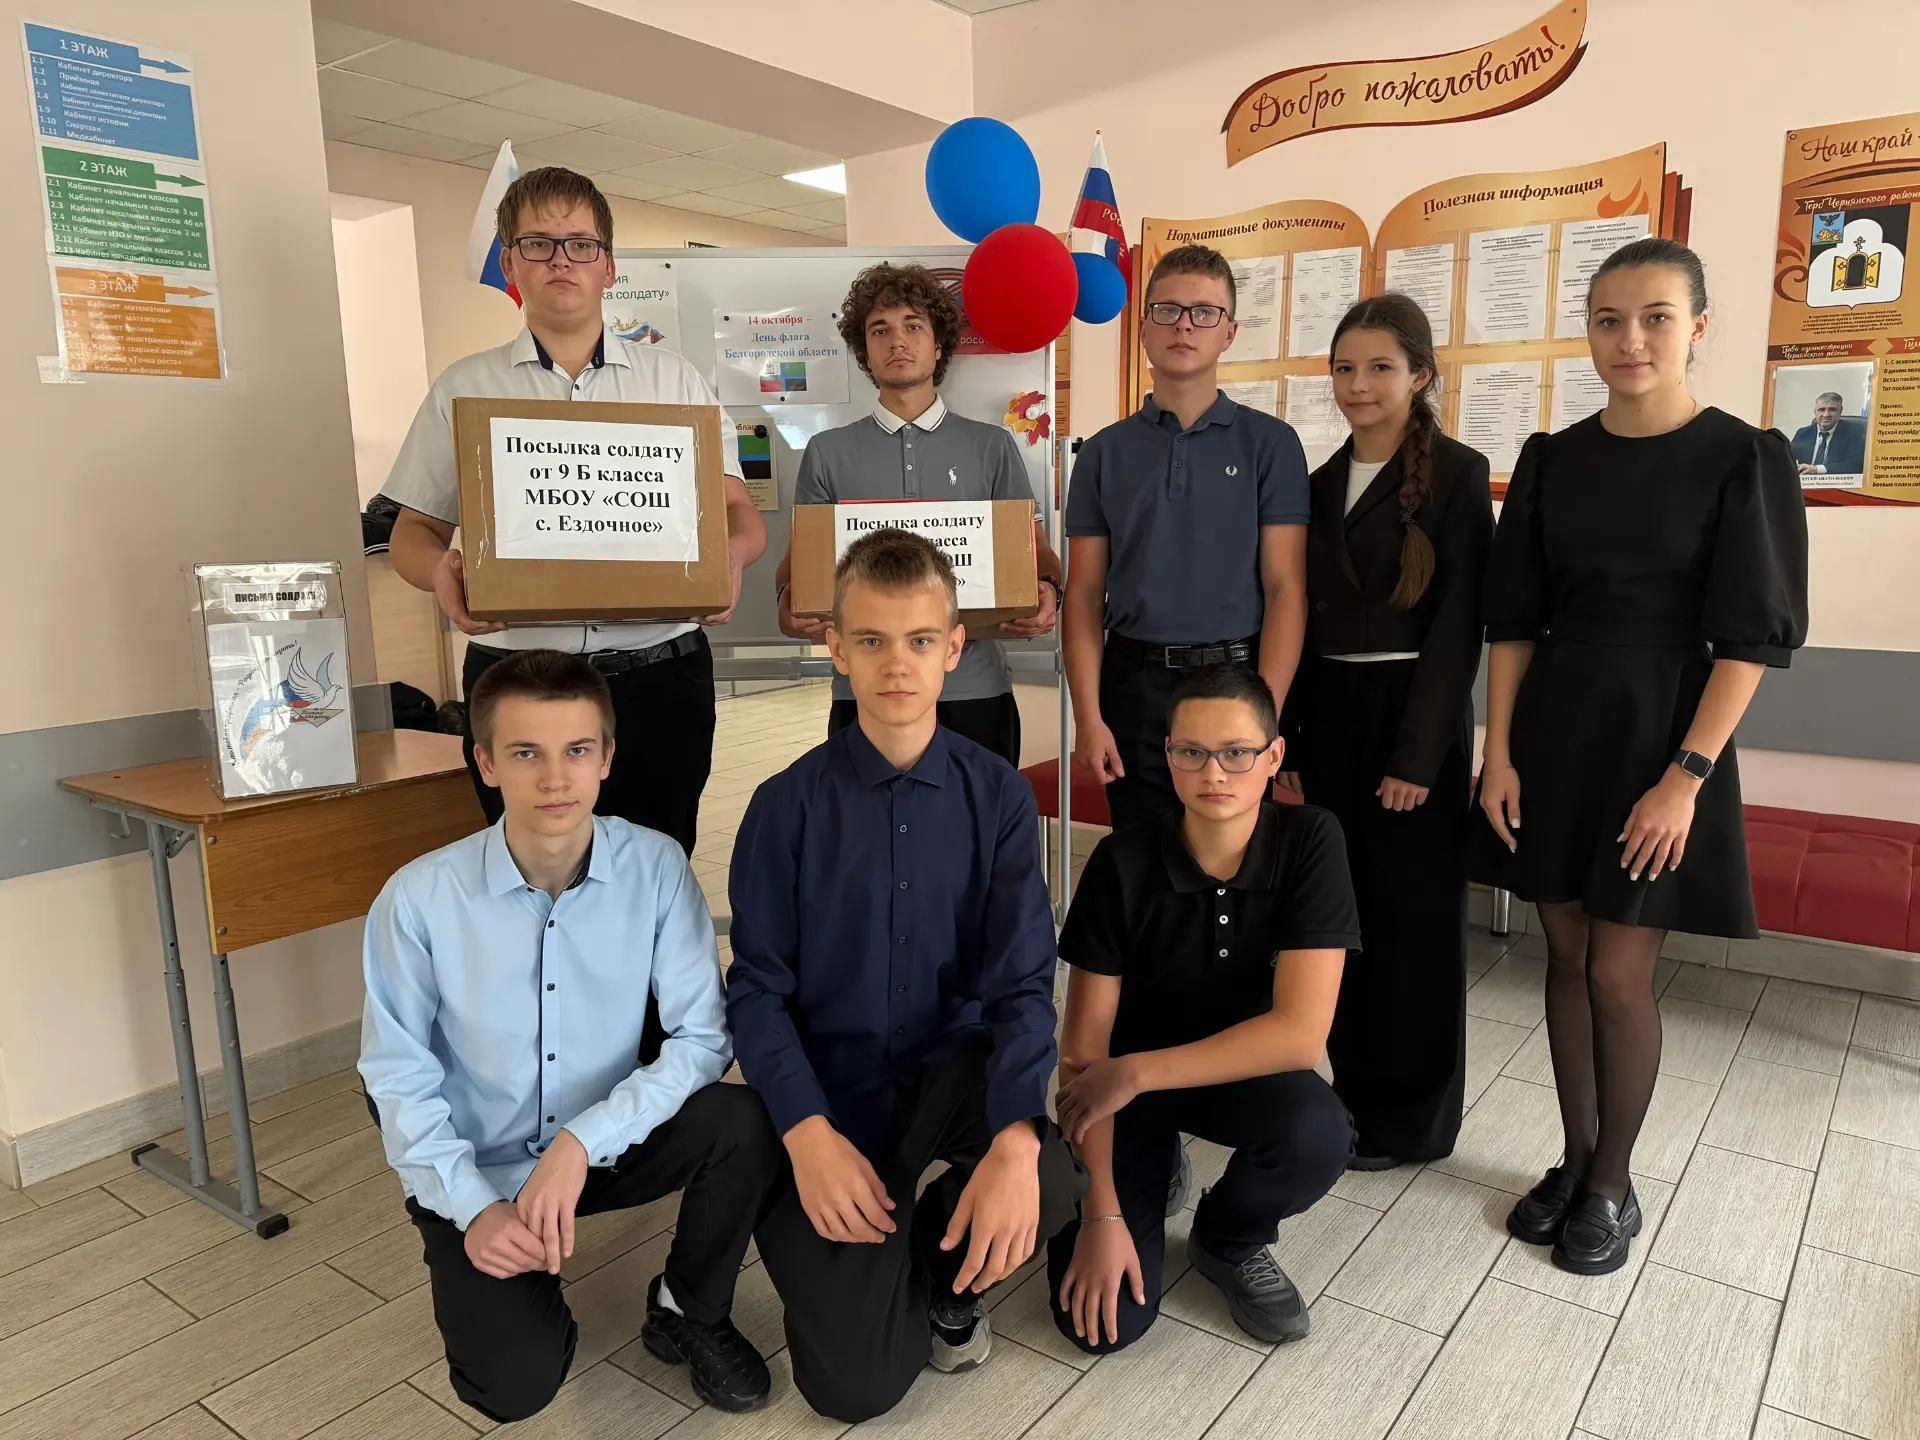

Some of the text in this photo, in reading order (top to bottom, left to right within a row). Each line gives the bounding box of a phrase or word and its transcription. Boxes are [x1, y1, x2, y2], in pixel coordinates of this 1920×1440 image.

[60, 40, 109, 59] 1 ЭТАЖ
[32, 56, 133, 83] 1.1 Кабинет директора
[34, 67, 100, 85] 1.2 Приёмная
[1249, 25, 1566, 132] Добро пожаловать!
[61, 83, 88, 92] Кабинет
[90, 88, 130, 101] заместителя
[132, 96, 165, 108] директора
[62, 96, 89, 106] Кабинет
[92, 101, 132, 114] заместителя
[133, 109, 167, 120] директора
[40, 116, 101, 133] 1.10 Спортзал
[64, 110, 96, 121] Кабинет
[98, 116, 129, 127] истории
[41, 127, 115, 145] 1.11 Медкабинет
[1801, 128, 1912, 162] Наш край
[80, 161, 127, 177] 2 ЭТАЖ
[68, 181, 101, 193] Кабинет
[104, 188, 147, 199] начальных
[149, 194, 178, 203] классов
[1423, 177, 1604, 216] Полезная информация
[50, 190, 62, 198] 2.2
[69, 193, 103, 204] Кабинет
[105, 199, 148, 210] начальных
[150, 205, 179, 214] классов
[1804, 198, 1828, 213] Герб
[1828, 195, 1887, 211] Чернянского
[70, 204, 104, 215] Кабинет
[106, 210, 149, 220] начальных
[151, 216, 180, 225] классов
[72, 215, 105, 226] Кабинет
[107, 221, 150, 232] начальных
[152, 226, 181, 235] классов
[1166, 217, 1346, 241] Нормативные документы
[73, 226, 107, 237] Кабинет
[109, 230, 126, 238] ИЗО
[134, 234, 164, 243] музыки
[55, 235, 72, 243] 2.12
[74, 237, 108, 248] Кабинет
[110, 242, 152, 253] начальных
[154, 247, 183, 256] классов
[75, 248, 110, 259] Кабинет
[111, 253, 154, 263] начальных
[156, 257, 184, 266] классов
[89, 280, 136, 293] 3 ЭТАЖ
[616, 289, 669, 301] солдату»
[87, 300, 120, 309] Кабинет
[124, 305, 171, 313] математики
[88, 311, 121, 319] Кабинет
[126, 316, 172, 324] математики
[90, 321, 122, 330] Кабинет
[748, 314, 803, 327] 14 октября
[126, 336, 178, 345] иностранного
[751, 331, 810, 344] День флага
[92, 343, 125, 351] Кабинет
[725, 348, 838, 360] Белгородской области
[130, 367, 182, 375] информатики
[505, 436, 684, 463] Посылка солдату
[530, 464, 664, 483] от 9 Б класса
[525, 488, 670, 508] МБОУ «СОШ
[535, 515, 663, 534] с. Ездочное»
[846, 514, 985, 531] Посылка солдату
[235, 593, 273, 602] ПИСЬМО
